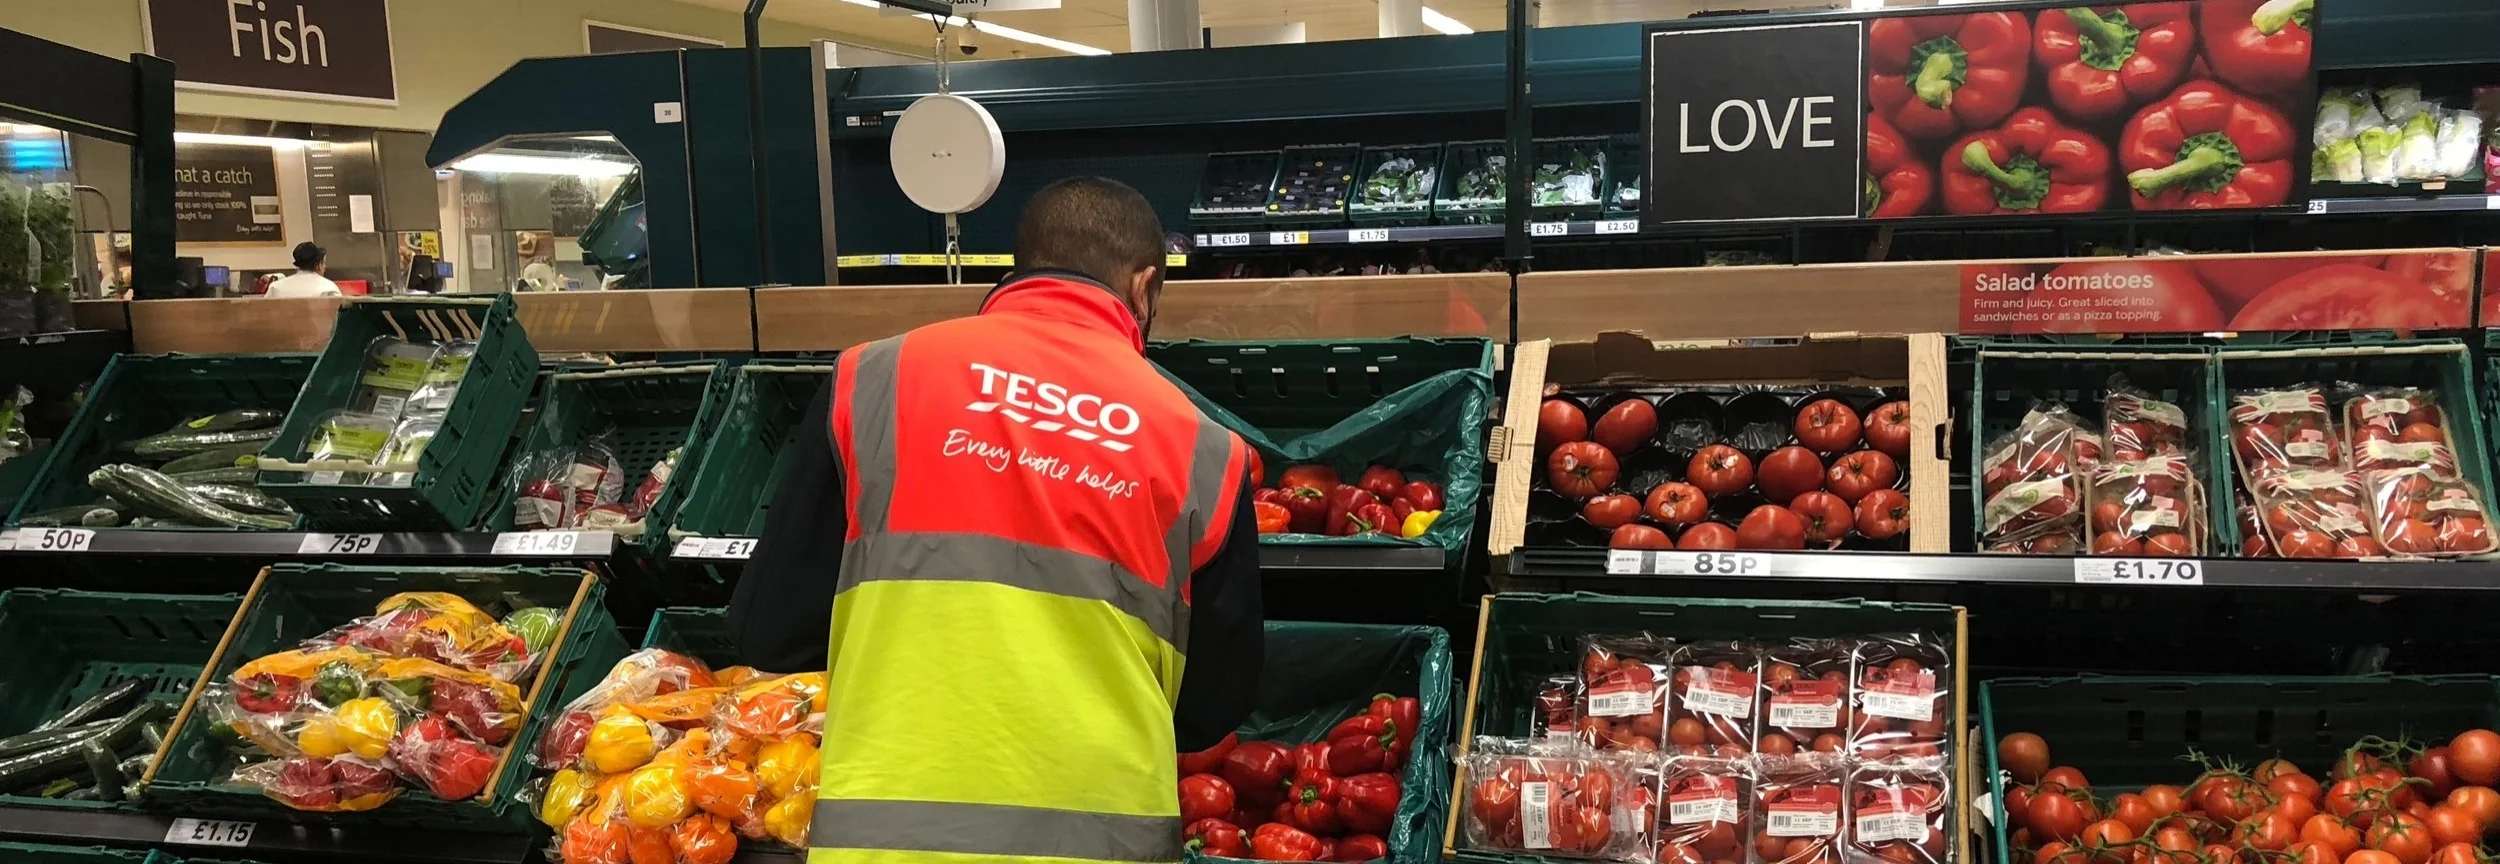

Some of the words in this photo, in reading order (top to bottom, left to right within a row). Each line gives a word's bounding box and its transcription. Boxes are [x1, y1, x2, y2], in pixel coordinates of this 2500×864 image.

[227, 0, 328, 67] Fish
[1680, 96, 1834, 153] LOVE
[202, 169, 211, 183] a
[215, 166, 252, 185] catch
[1360, 231, 1386, 240] £1.75
[1536, 224, 1563, 234] £1.75
[1607, 222, 1635, 231] £2.50
[1222, 235, 1247, 244] £1.50
[1283, 233, 1296, 243] £1
[1975, 273, 2036, 292] Salad
[2043, 272, 2154, 291] tomatoes
[1974, 299, 2000, 308] Firm
[2003, 299, 2024, 308] and
[2026, 299, 2054, 310] juicy.
[2059, 298, 2091, 308] Great
[2094, 297, 2128, 307] sliced
[2132, 296, 2154, 306] into
[1973, 311, 2039, 322] sandwiches
[2042, 313, 2054, 321] or
[2084, 311, 2112, 322] pizza
[2115, 310, 2162, 322] topping.
[970, 362, 1140, 435] TESCO
[943, 429, 1011, 472] Every
[1018, 447, 1070, 480] little
[1076, 465, 1139, 500] helps
[41, 529, 86, 549] 50p
[328, 534, 371, 552] 75p
[517, 534, 574, 550] £1.49
[1694, 553, 1757, 574] 85p
[2113, 560, 2196, 580] £1.70
[192, 821, 252, 842] £1.15
